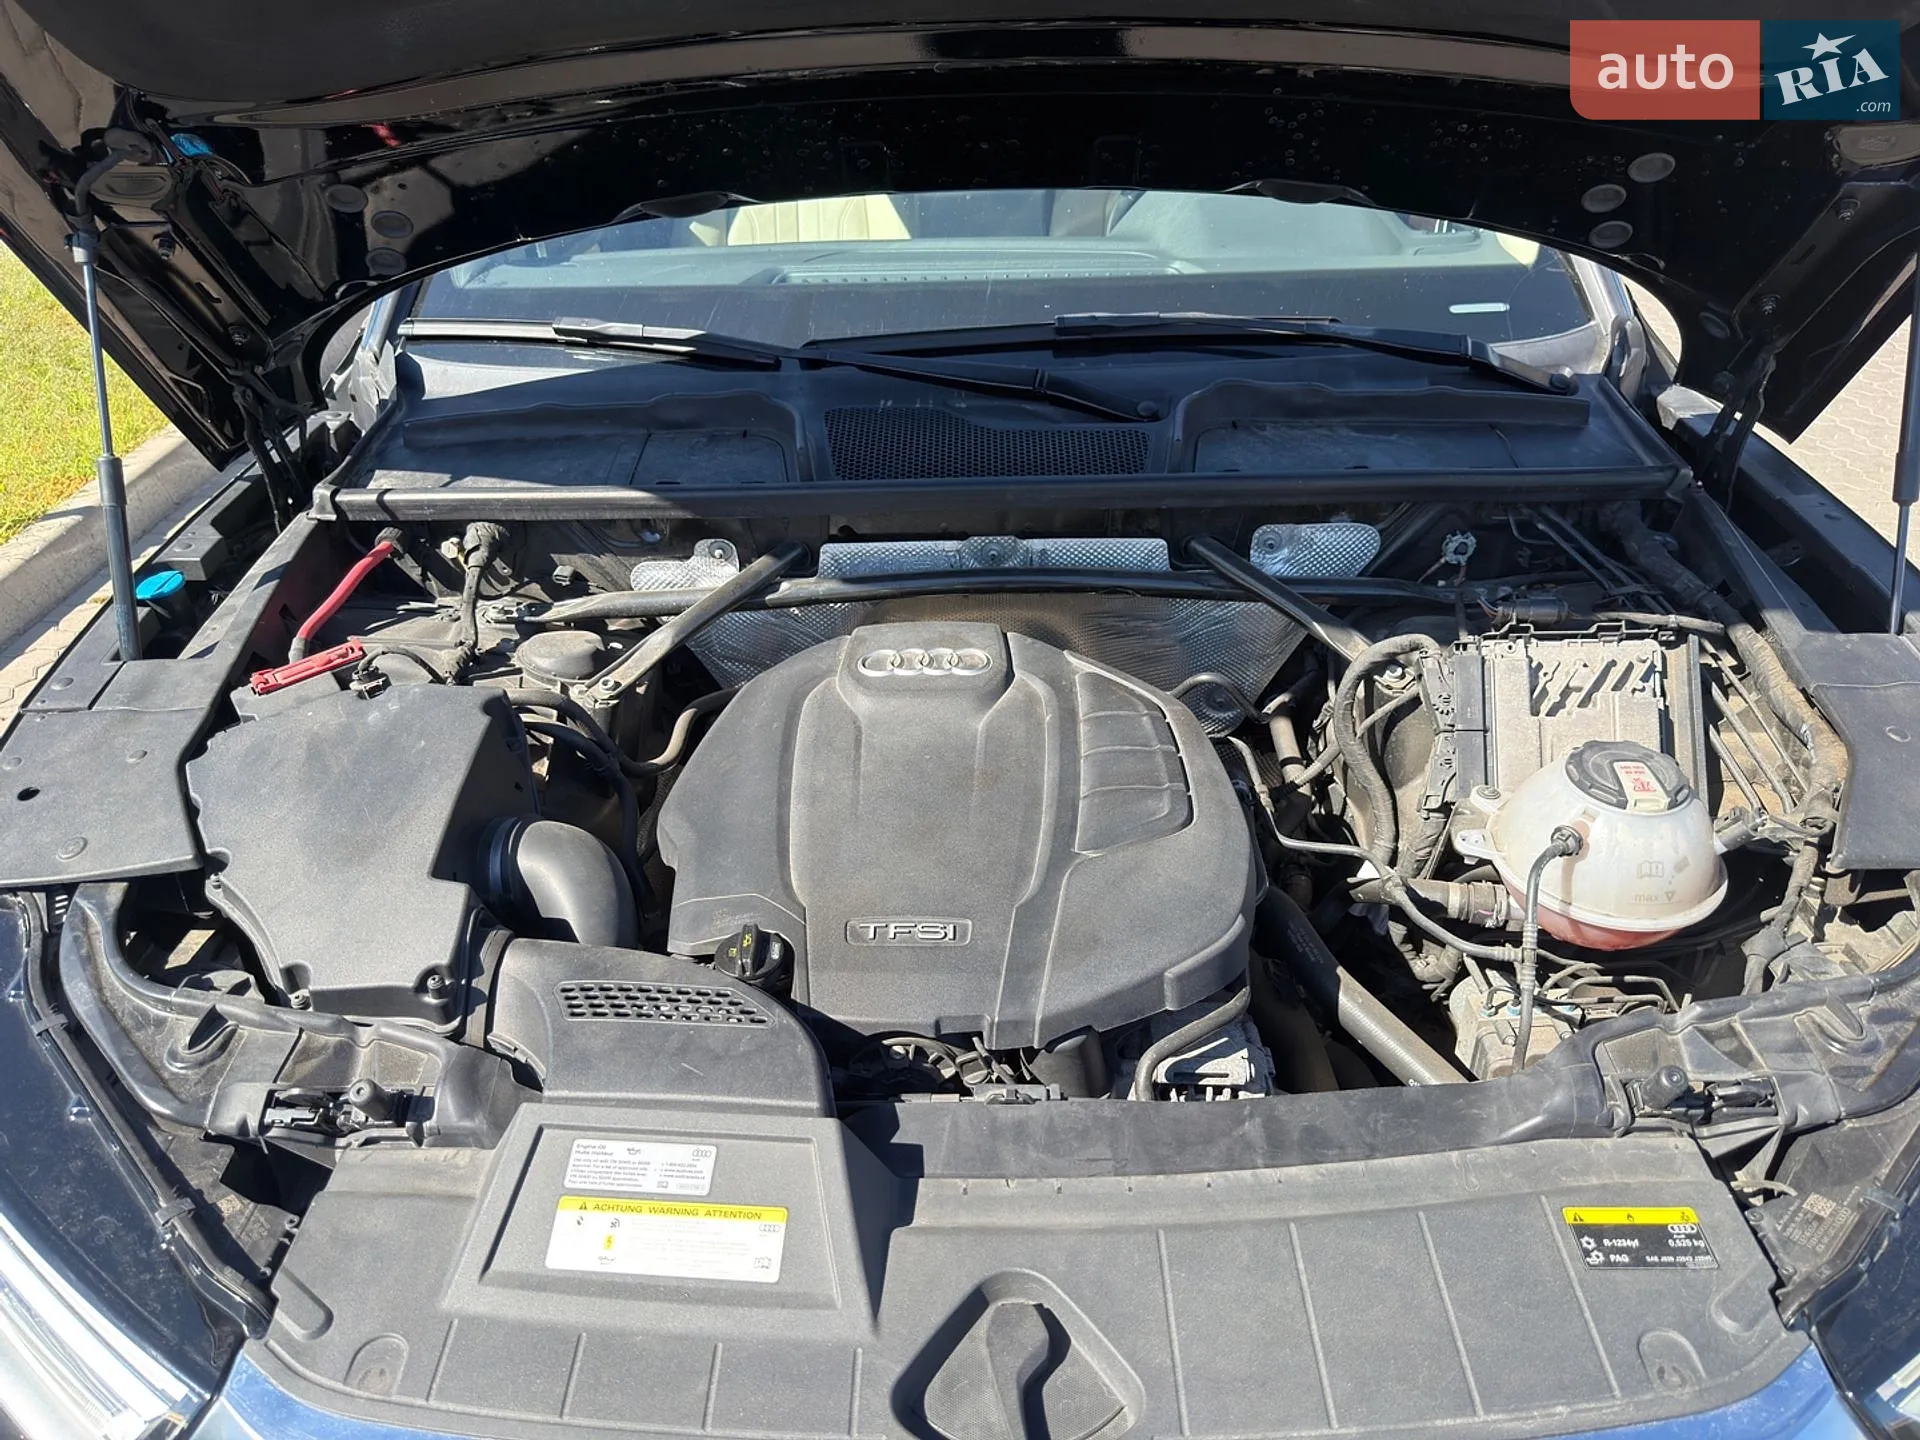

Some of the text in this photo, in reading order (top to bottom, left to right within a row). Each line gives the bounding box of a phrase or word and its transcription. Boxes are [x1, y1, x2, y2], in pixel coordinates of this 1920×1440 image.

[859, 923, 956, 941] TFSI
[593, 1204, 762, 1220] ACHTUNG WARNING ATTENTION
